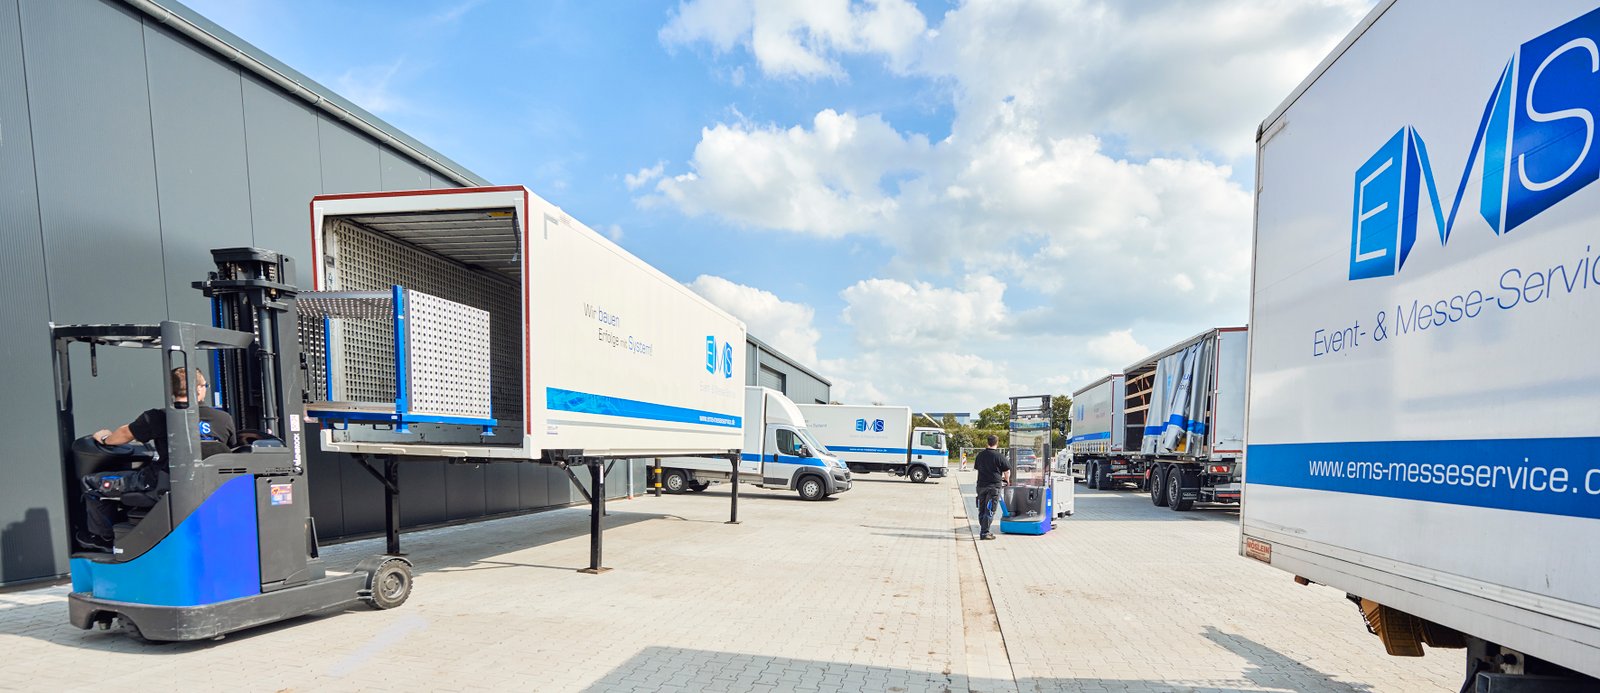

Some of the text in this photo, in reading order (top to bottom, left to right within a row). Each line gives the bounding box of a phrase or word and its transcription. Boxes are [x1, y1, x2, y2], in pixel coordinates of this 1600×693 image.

[1349, 7, 1600, 281] EMS
[583, 302, 620, 328] Wir bauen
[1313, 320, 1366, 357] Event-
[1373, 311, 1388, 342] &
[706, 335, 733, 379] EMS
[855, 418, 884, 432] EMS
